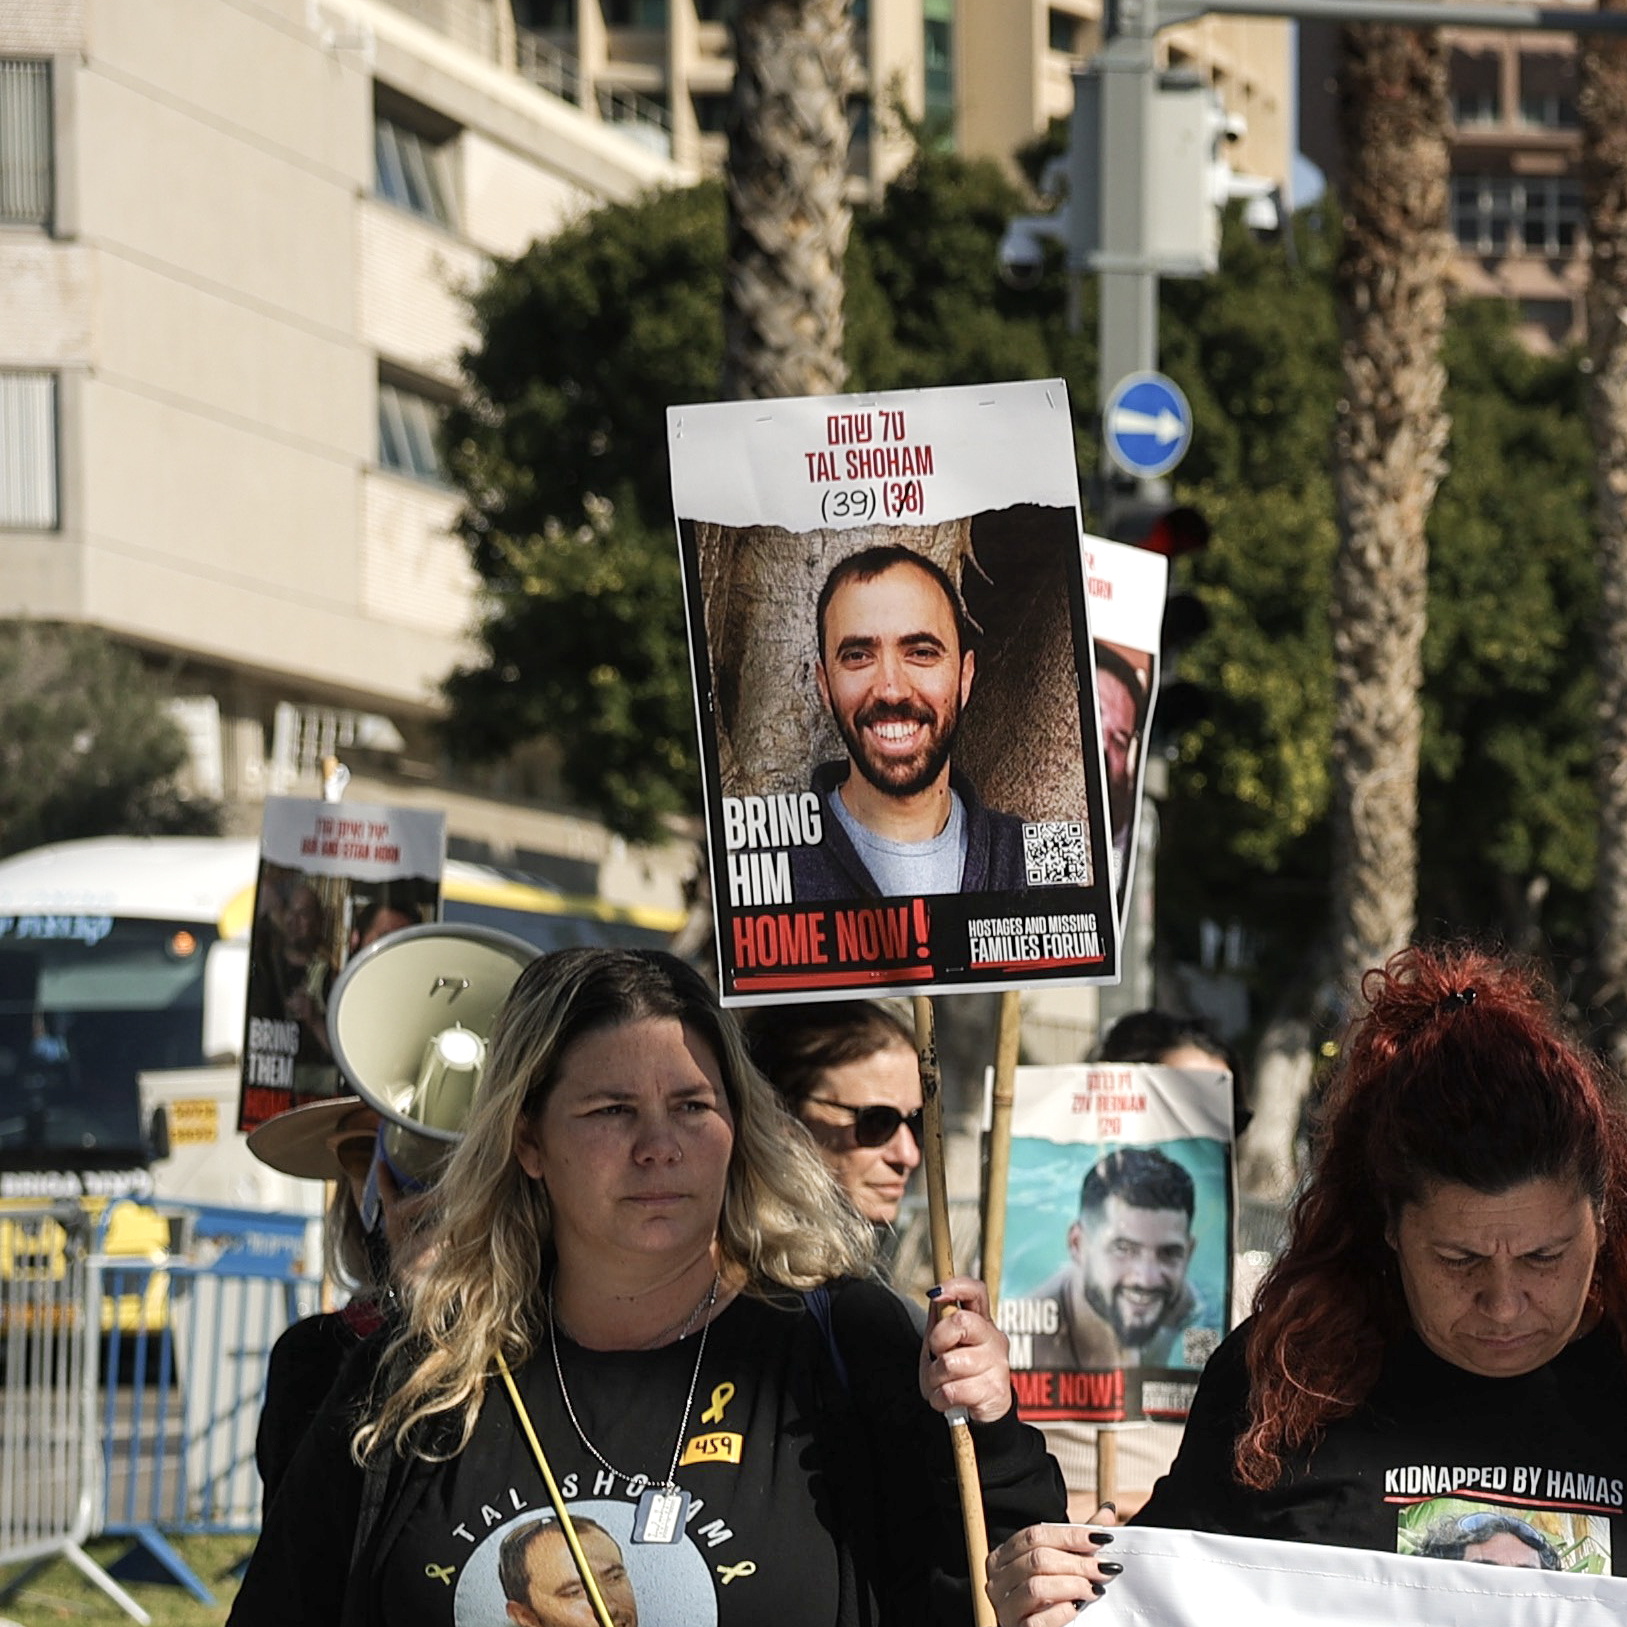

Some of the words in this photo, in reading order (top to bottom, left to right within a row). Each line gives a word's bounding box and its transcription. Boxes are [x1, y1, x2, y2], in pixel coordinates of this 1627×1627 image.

[827, 415, 873, 445] שהם
[880, 410, 905, 443] טל
[805, 451, 841, 483] TAL
[846, 445, 934, 481] SHOHAM
[821, 487, 877, 522] (39)
[724, 793, 822, 850] BRING
[729, 850, 792, 907] HIM
[733, 909, 828, 969] HOME
[837, 899, 931, 962] NOW!
[969, 918, 1024, 936] HOSTAGES
[1025, 916, 1047, 934] AND
[1048, 913, 1097, 933] MISSING
[970, 935, 1040, 963] FAMILIES
[1043, 932, 1099, 959] FORUM
[1059, 1368, 1124, 1407] NOW!
[694, 1437, 732, 1456] 459
[1385, 1466, 1507, 1494] KIDNAPPED
[1513, 1467, 1541, 1496] BY
[1546, 1469, 1624, 1506] HAMAS
[452, 1488, 528, 1544] TAL
[562, 1470, 734, 1548] SHOAM
